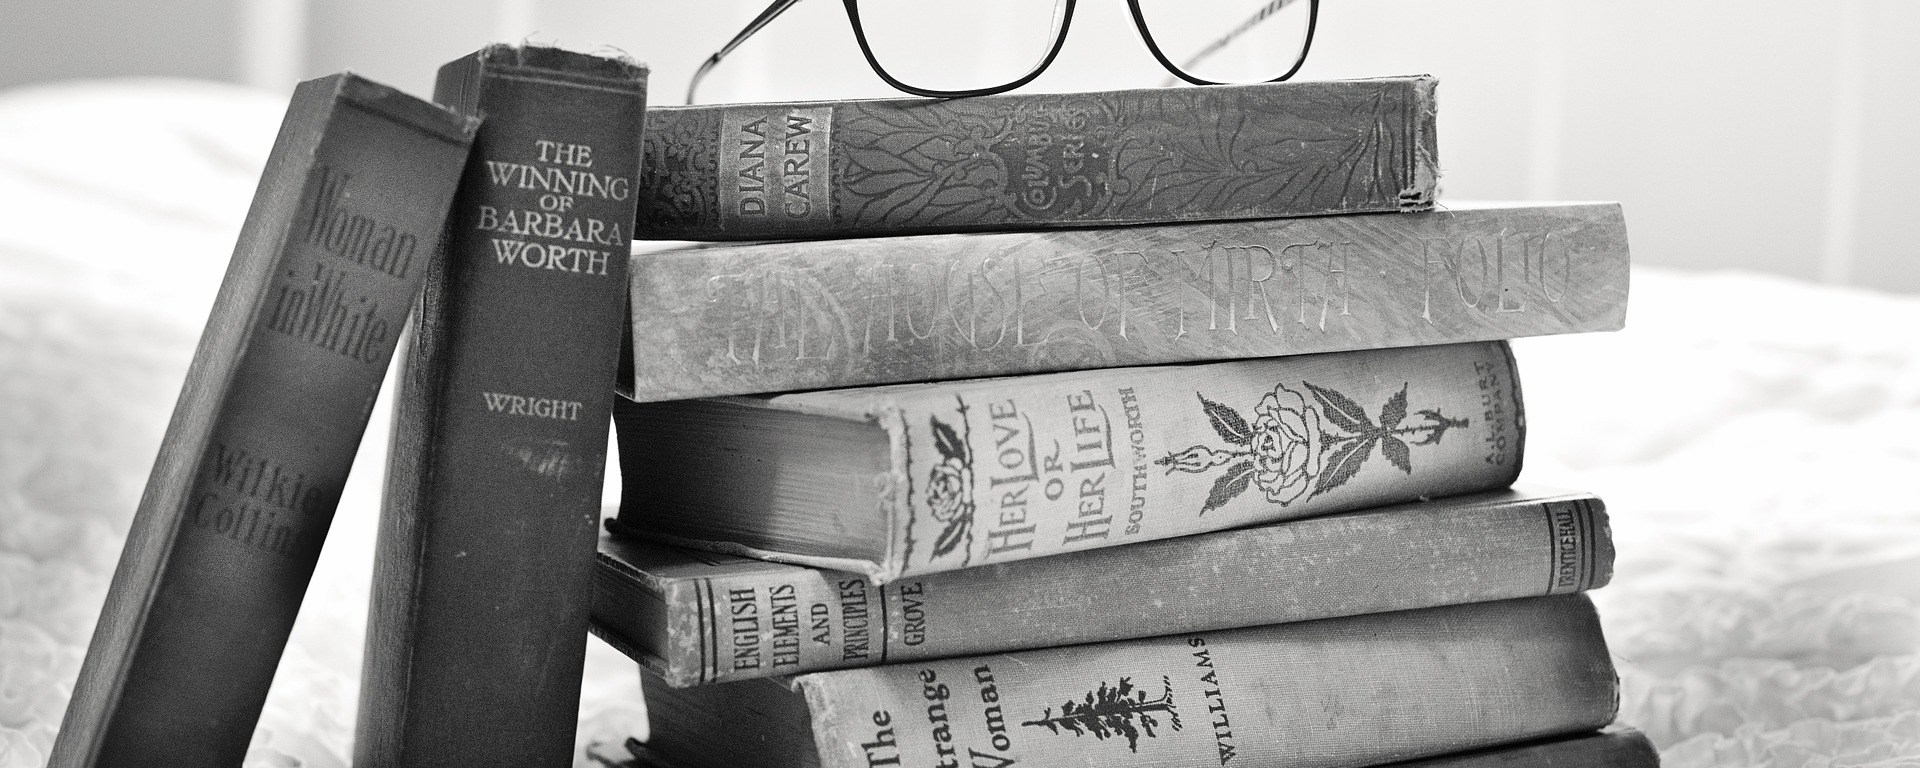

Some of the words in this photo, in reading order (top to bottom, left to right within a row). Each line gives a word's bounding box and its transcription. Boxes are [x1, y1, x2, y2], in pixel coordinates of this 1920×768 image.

[486, 160, 630, 201] WINNING
[536, 139, 593, 168] THE
[739, 115, 768, 216] DIANA
[783, 115, 813, 218] CAREW
[304, 165, 417, 279] Woman
[476, 205, 625, 247] BARBARA
[540, 194, 575, 213] OF
[492, 238, 611, 276] WORTH
[706, 266, 837, 368] THE
[1077, 249, 1150, 342] OF
[1170, 239, 1353, 341] MIRTH
[1420, 229, 1571, 326] FOLIO
[483, 391, 583, 422] WRIGHT
[210, 442, 323, 516] Wilkie
[1044, 439, 1065, 501] OR
[1118, 386, 1148, 536] SOUTHWORTH
[192, 489, 311, 554] Collin
[729, 587, 761, 671] ENGLISH
[769, 583, 800, 669] ELEMENTS
[811, 602, 831, 646] AND
[838, 578, 870, 662] PRINCIPLES
[900, 581, 926, 647] GROVE
[917, 667, 960, 768] trange
[1187, 638, 1237, 767] WILLIAMS
[861, 709, 901, 768] The
